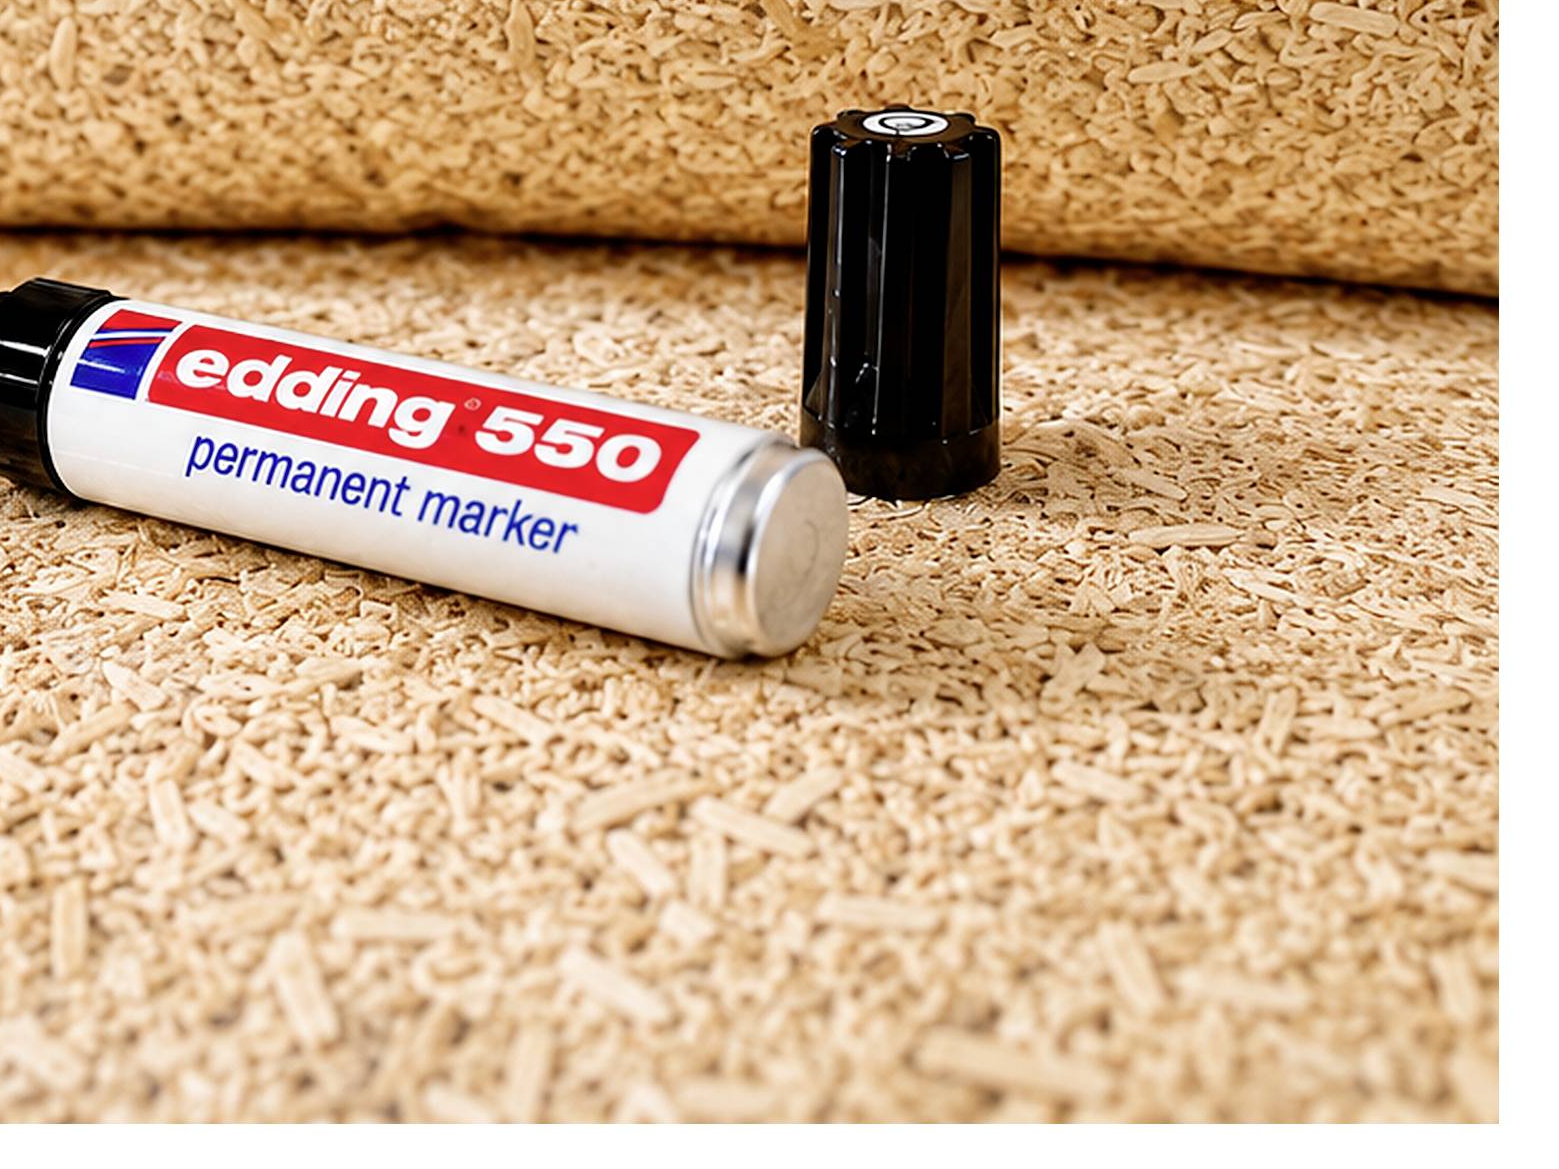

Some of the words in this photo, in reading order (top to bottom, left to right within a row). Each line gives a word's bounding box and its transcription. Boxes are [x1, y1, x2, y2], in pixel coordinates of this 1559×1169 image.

[175, 340, 456, 450] edding
[474, 405, 663, 483] 550
[184, 435, 411, 528] permanent
[415, 488, 580, 554] marker
